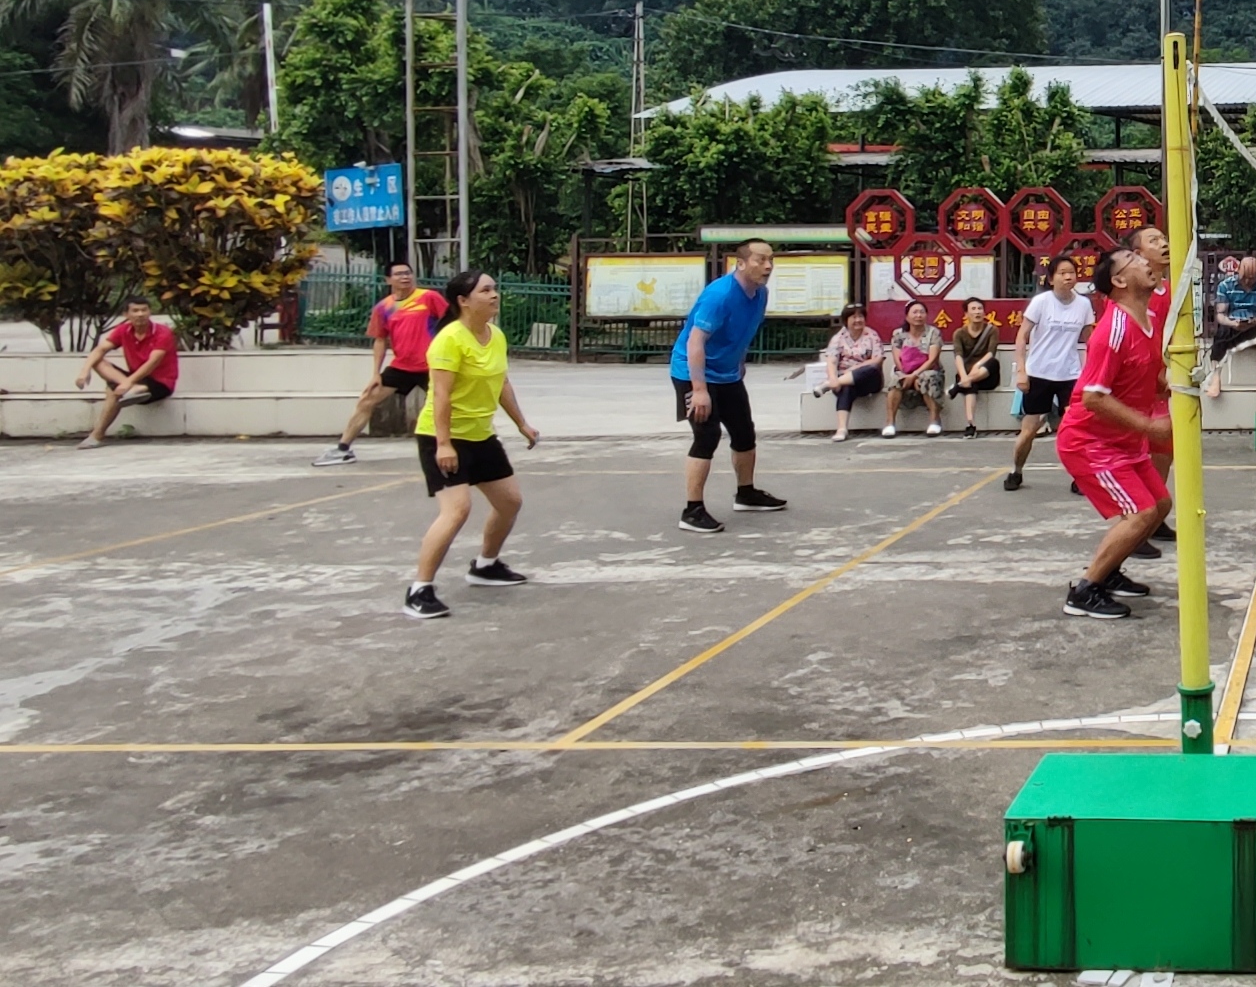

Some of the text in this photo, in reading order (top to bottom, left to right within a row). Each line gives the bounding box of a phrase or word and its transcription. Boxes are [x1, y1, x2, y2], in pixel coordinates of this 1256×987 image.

[865, 211, 892, 222] 富强
[957, 210, 985, 220] 文明
[1023, 209, 1050, 220] 自由
[1114, 208, 1142, 219] 公正
[866, 223, 893, 233] 民主
[957, 222, 984, 232] 和谐
[1023, 221, 1050, 231] 平等
[1115, 219, 1142, 229] 法治
[912, 256, 939, 267] 爱国
[912, 268, 939, 279] 敬业
